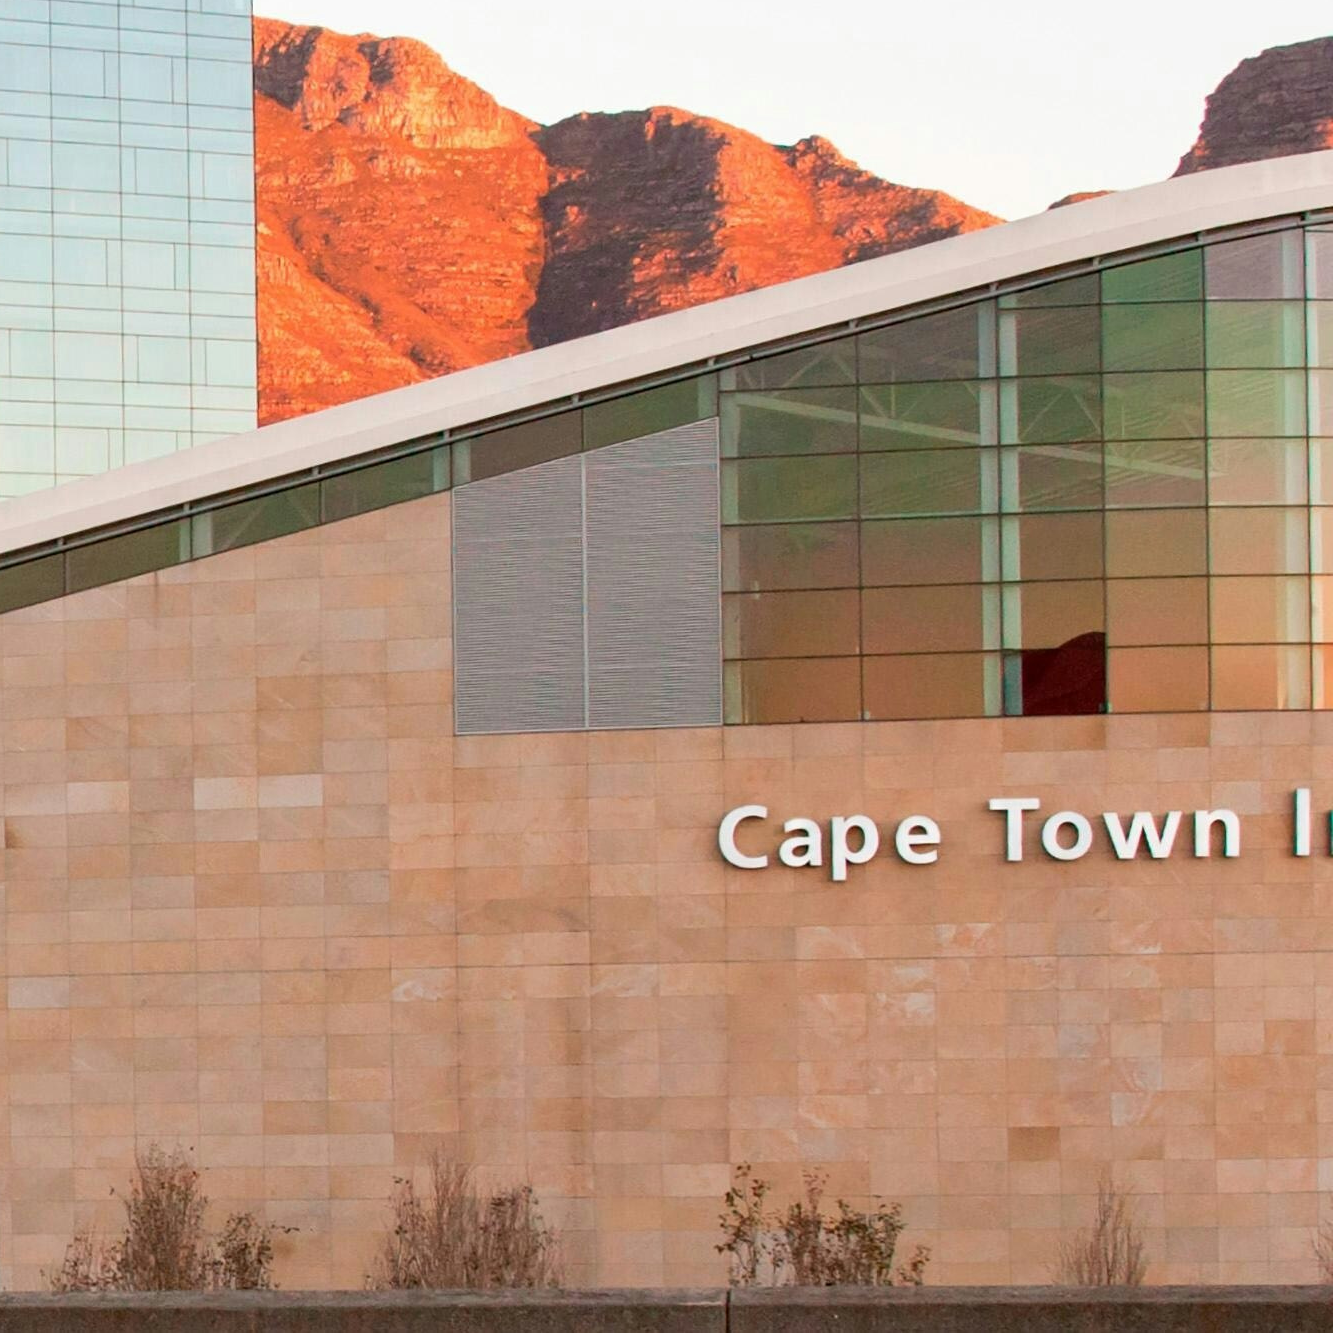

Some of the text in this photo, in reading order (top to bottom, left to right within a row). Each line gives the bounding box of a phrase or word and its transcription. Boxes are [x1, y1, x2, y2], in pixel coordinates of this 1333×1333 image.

[717, 787, 1333, 881] Cape Town I
